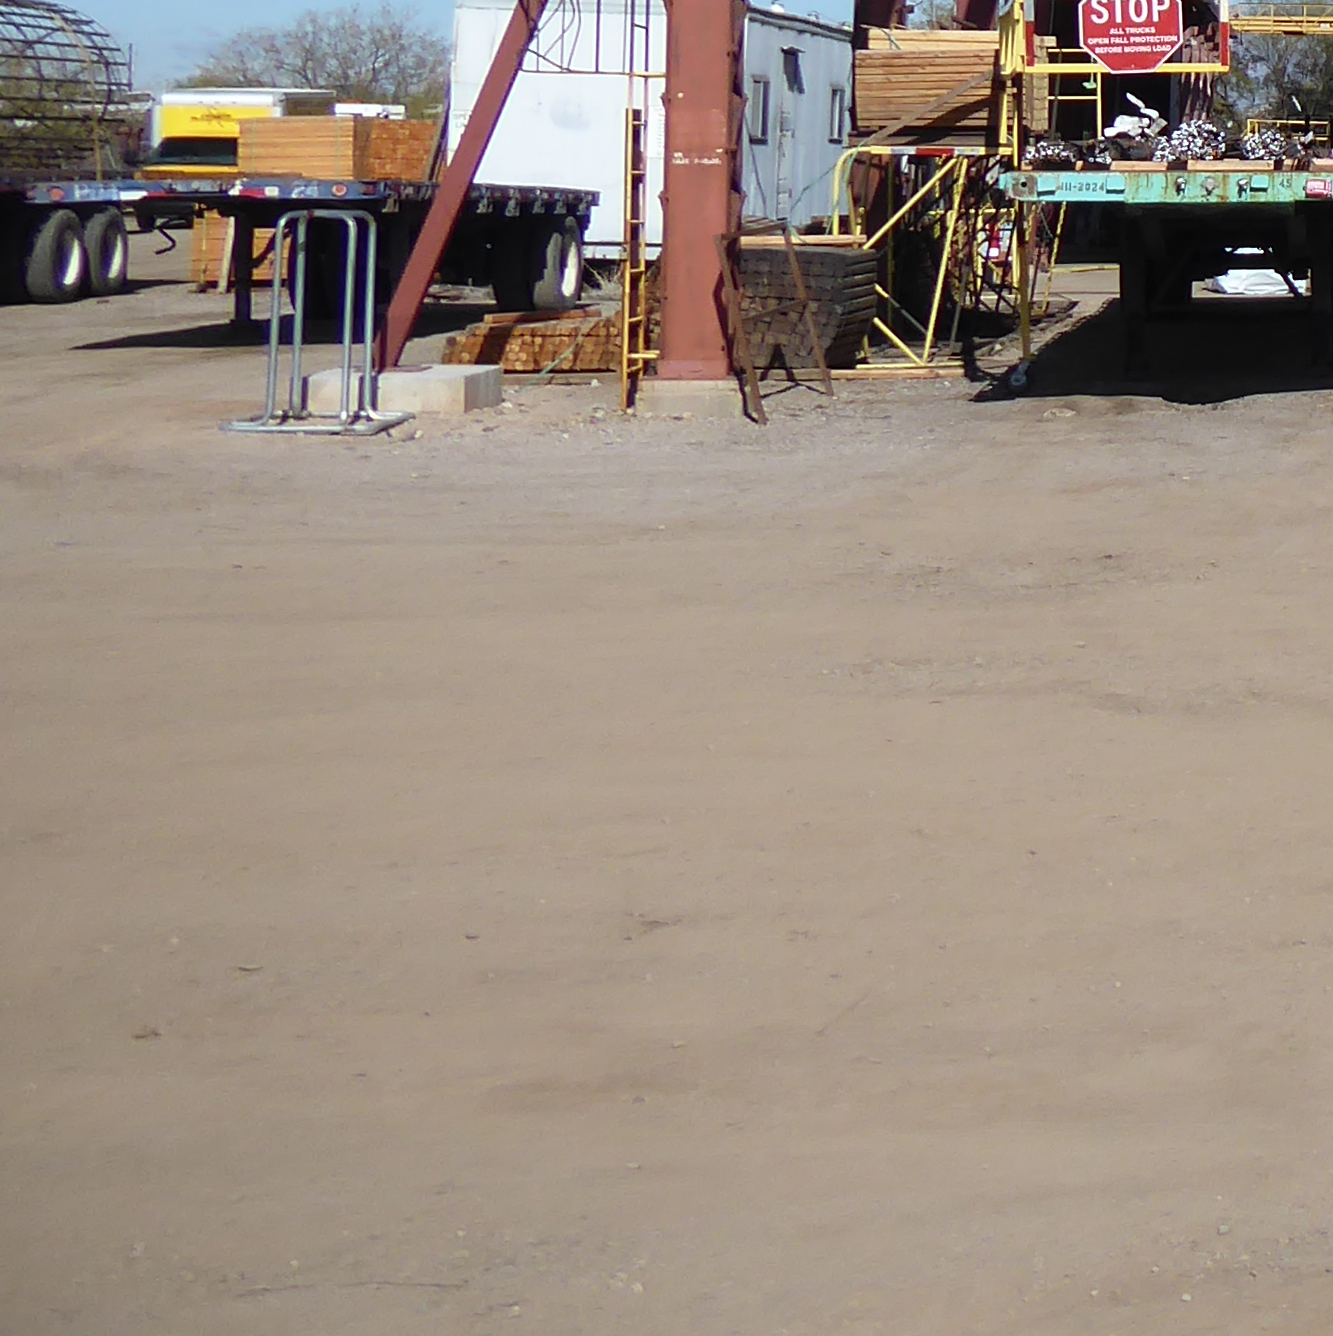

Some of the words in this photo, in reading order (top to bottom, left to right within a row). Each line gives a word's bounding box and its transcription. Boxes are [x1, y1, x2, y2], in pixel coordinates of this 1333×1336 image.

[1125, 26, 1156, 34] TRUCKS
[1110, 36, 1129, 44] FALL
[1130, 35, 1178, 43] PROTECTION
[1095, 46, 1122, 54] BEFORE
[1124, 45, 1151, 53] MOVING
[1153, 44, 1171, 52] LOAD
